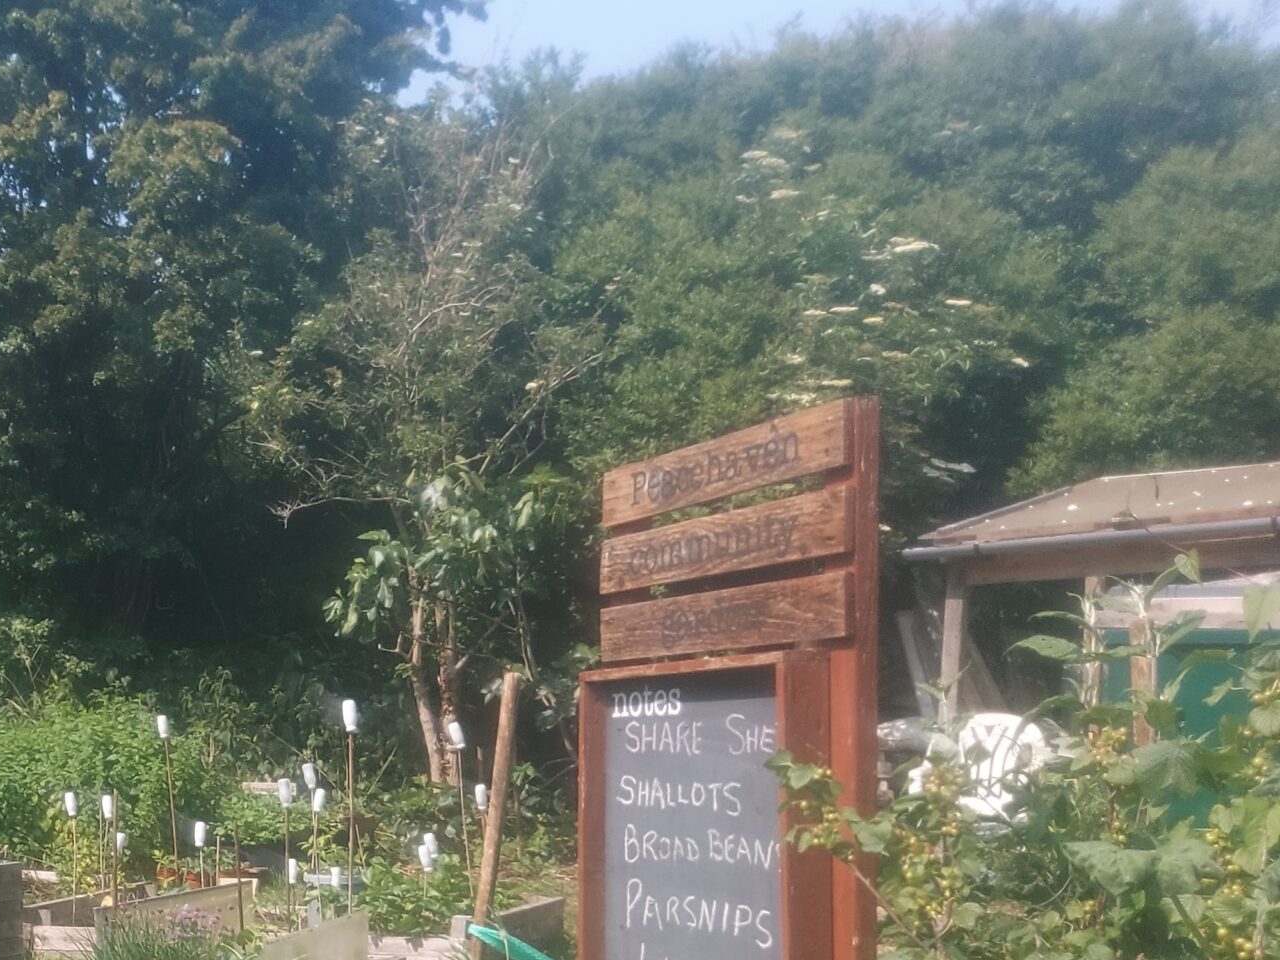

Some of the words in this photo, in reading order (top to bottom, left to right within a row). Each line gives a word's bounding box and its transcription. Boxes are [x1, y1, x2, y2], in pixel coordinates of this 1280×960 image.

[631, 431, 801, 506] Peacehaven
[627, 514, 799, 577] community
[612, 686, 682, 718] notes
[625, 720, 704, 757] SHARE
[726, 713, 778, 756] SHE
[616, 774, 742, 817] SHALLOTS
[624, 823, 700, 864] BROAD
[707, 828, 781, 871] BEAN
[626, 878, 772, 948] PARSNIPS
